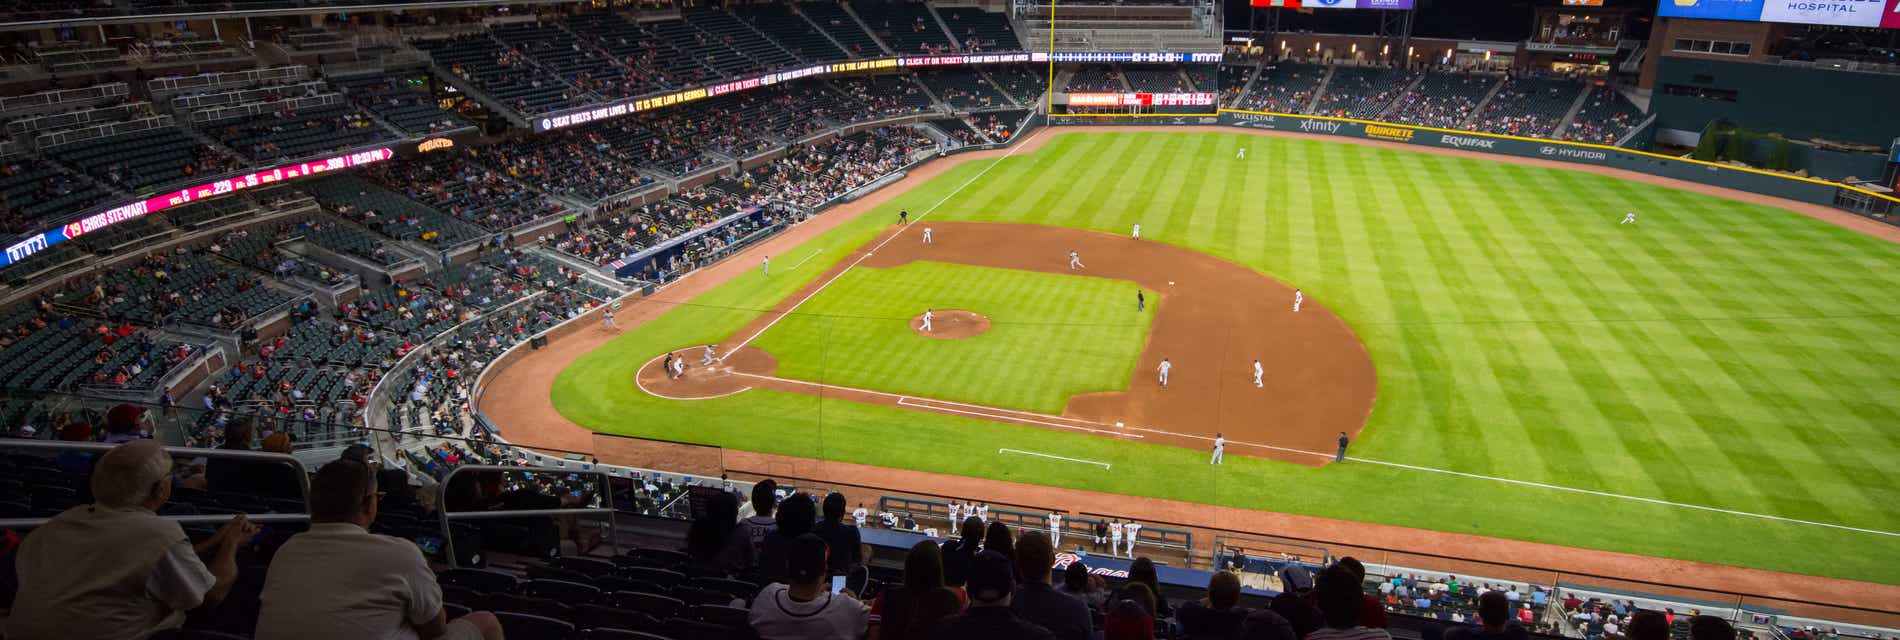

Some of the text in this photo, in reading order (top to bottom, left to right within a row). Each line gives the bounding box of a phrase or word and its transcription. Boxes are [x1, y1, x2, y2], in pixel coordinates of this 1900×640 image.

[1787, 3, 1857, 13] HOSPITAL
[906, 58, 922, 66] CLICK
[715, 82, 728, 95] CLICK
[636, 88, 706, 112] IT IS THE LAW IN GEORGIA
[552, 104, 627, 128] SEAT BELTS SAVE LIVES
[1232, 112, 1274, 122] WELLSTAR
[1300, 118, 1341, 134] xfinity
[1364, 125, 1415, 139] QUIKRETE
[1441, 134, 1496, 149] EQUIFAX
[372, 150, 384, 161] PM
[1558, 149, 1606, 160] HYUNDAI
[274, 168, 282, 180] 0
[301, 164, 308, 174] 0
[245, 174, 258, 187] 35
[213, 180, 232, 195] .229
[182, 190, 190, 202] C
[70, 200, 148, 237] 19 CHRIS STEWART
